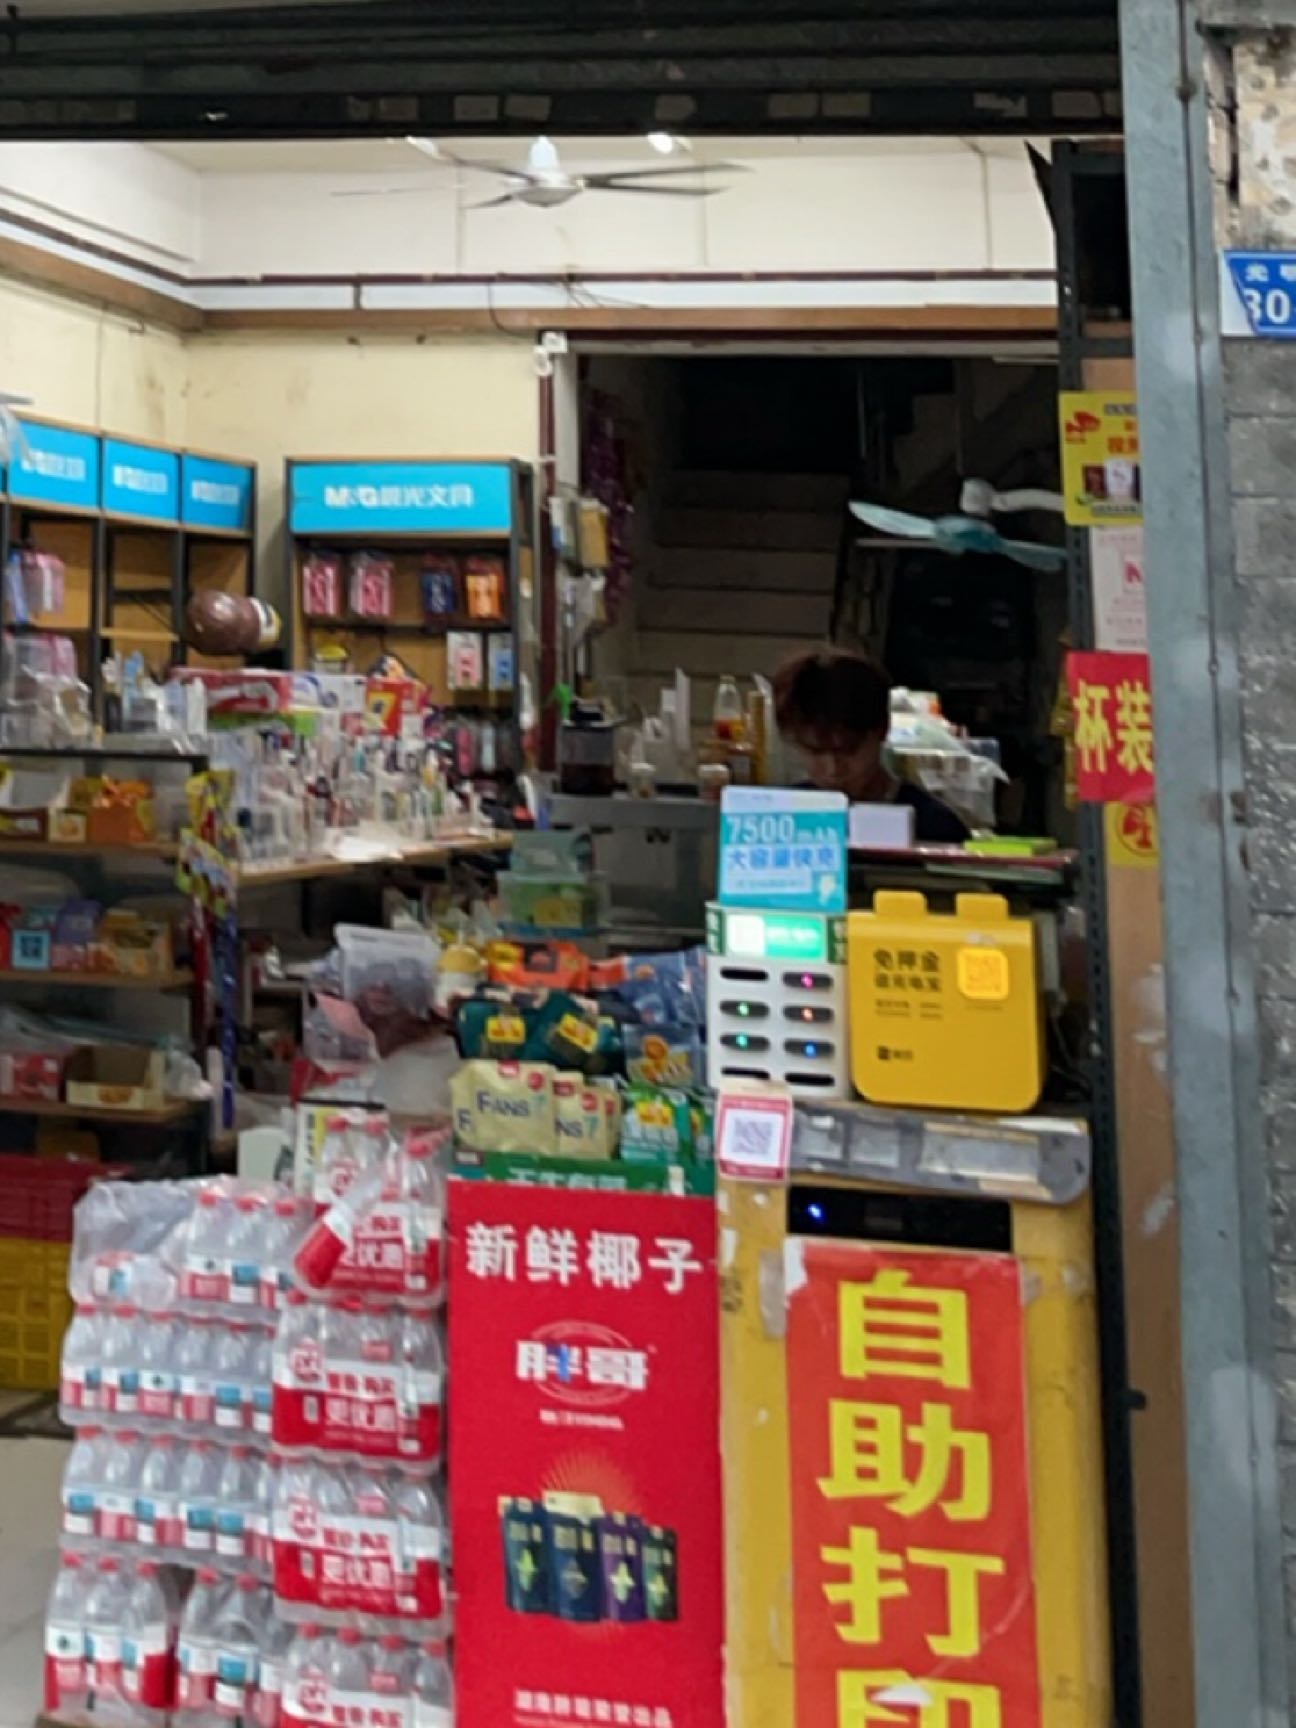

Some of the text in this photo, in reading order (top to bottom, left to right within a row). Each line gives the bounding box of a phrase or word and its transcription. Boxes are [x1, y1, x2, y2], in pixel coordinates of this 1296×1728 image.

[465, 1222, 702, 1294] 新鲜椰子
[516, 1339, 649, 1391] 胖哥
